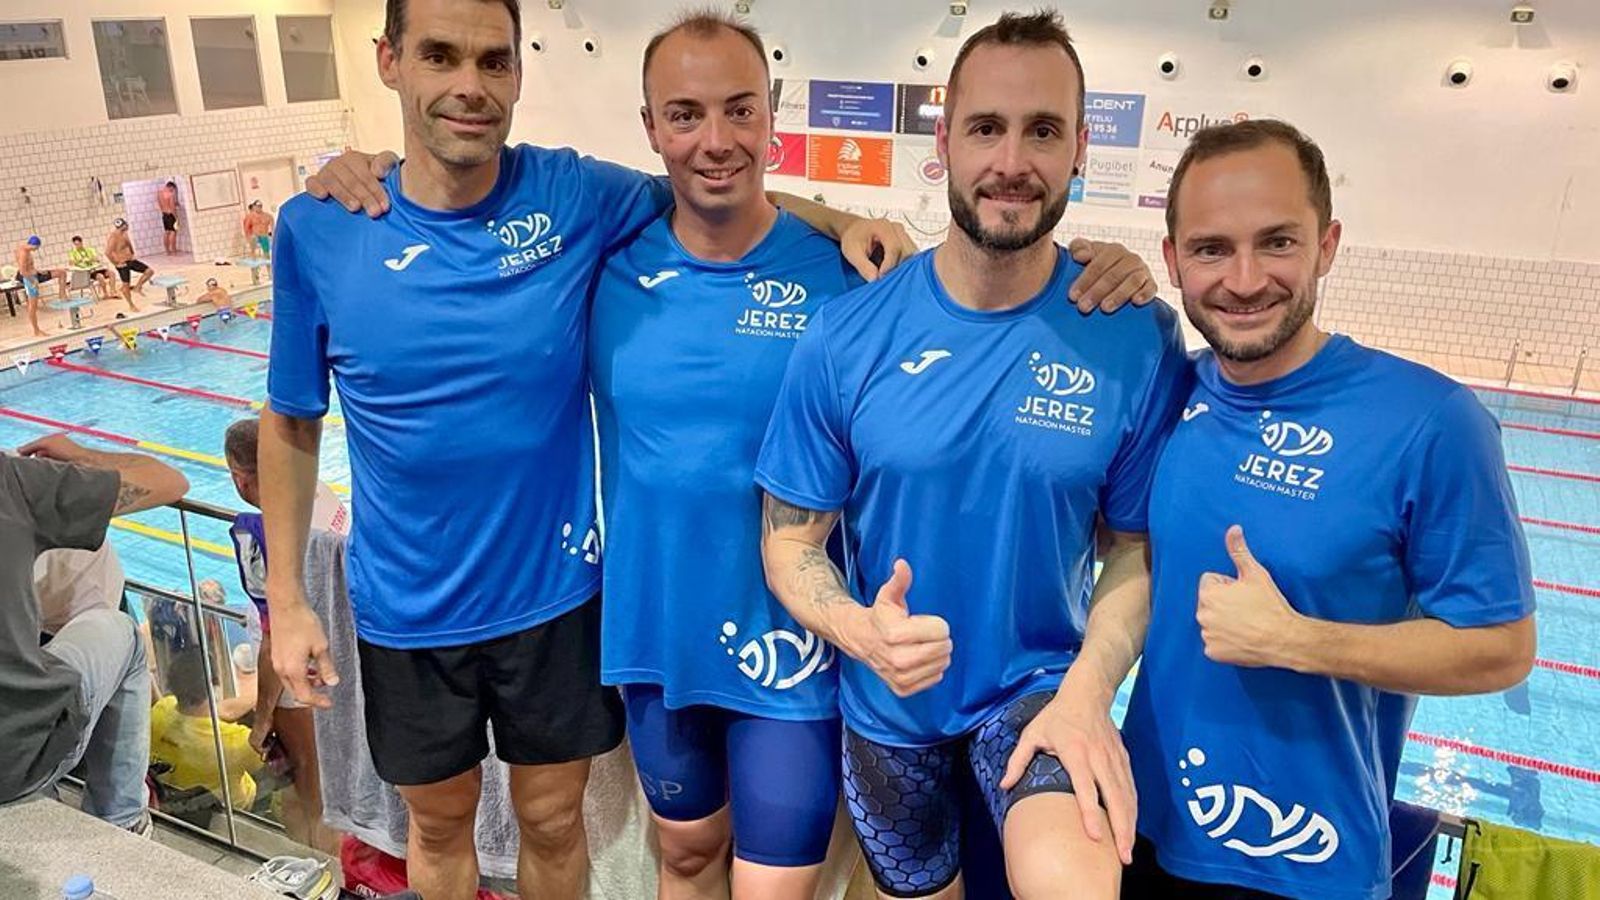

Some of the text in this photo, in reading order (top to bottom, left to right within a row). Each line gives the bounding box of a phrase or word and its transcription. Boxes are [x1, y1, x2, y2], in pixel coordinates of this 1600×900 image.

[498, 234, 563, 270] JEREZ
[735, 327, 774, 337] NATACION
[736, 309, 808, 330] JEREZ
[1017, 395, 1095, 426] JEREZ
[1014, 415, 1092, 437] NATACION MASTER
[1238, 453, 1324, 490] JEREZ
[1234, 473, 1316, 501] NATACION MASTER
